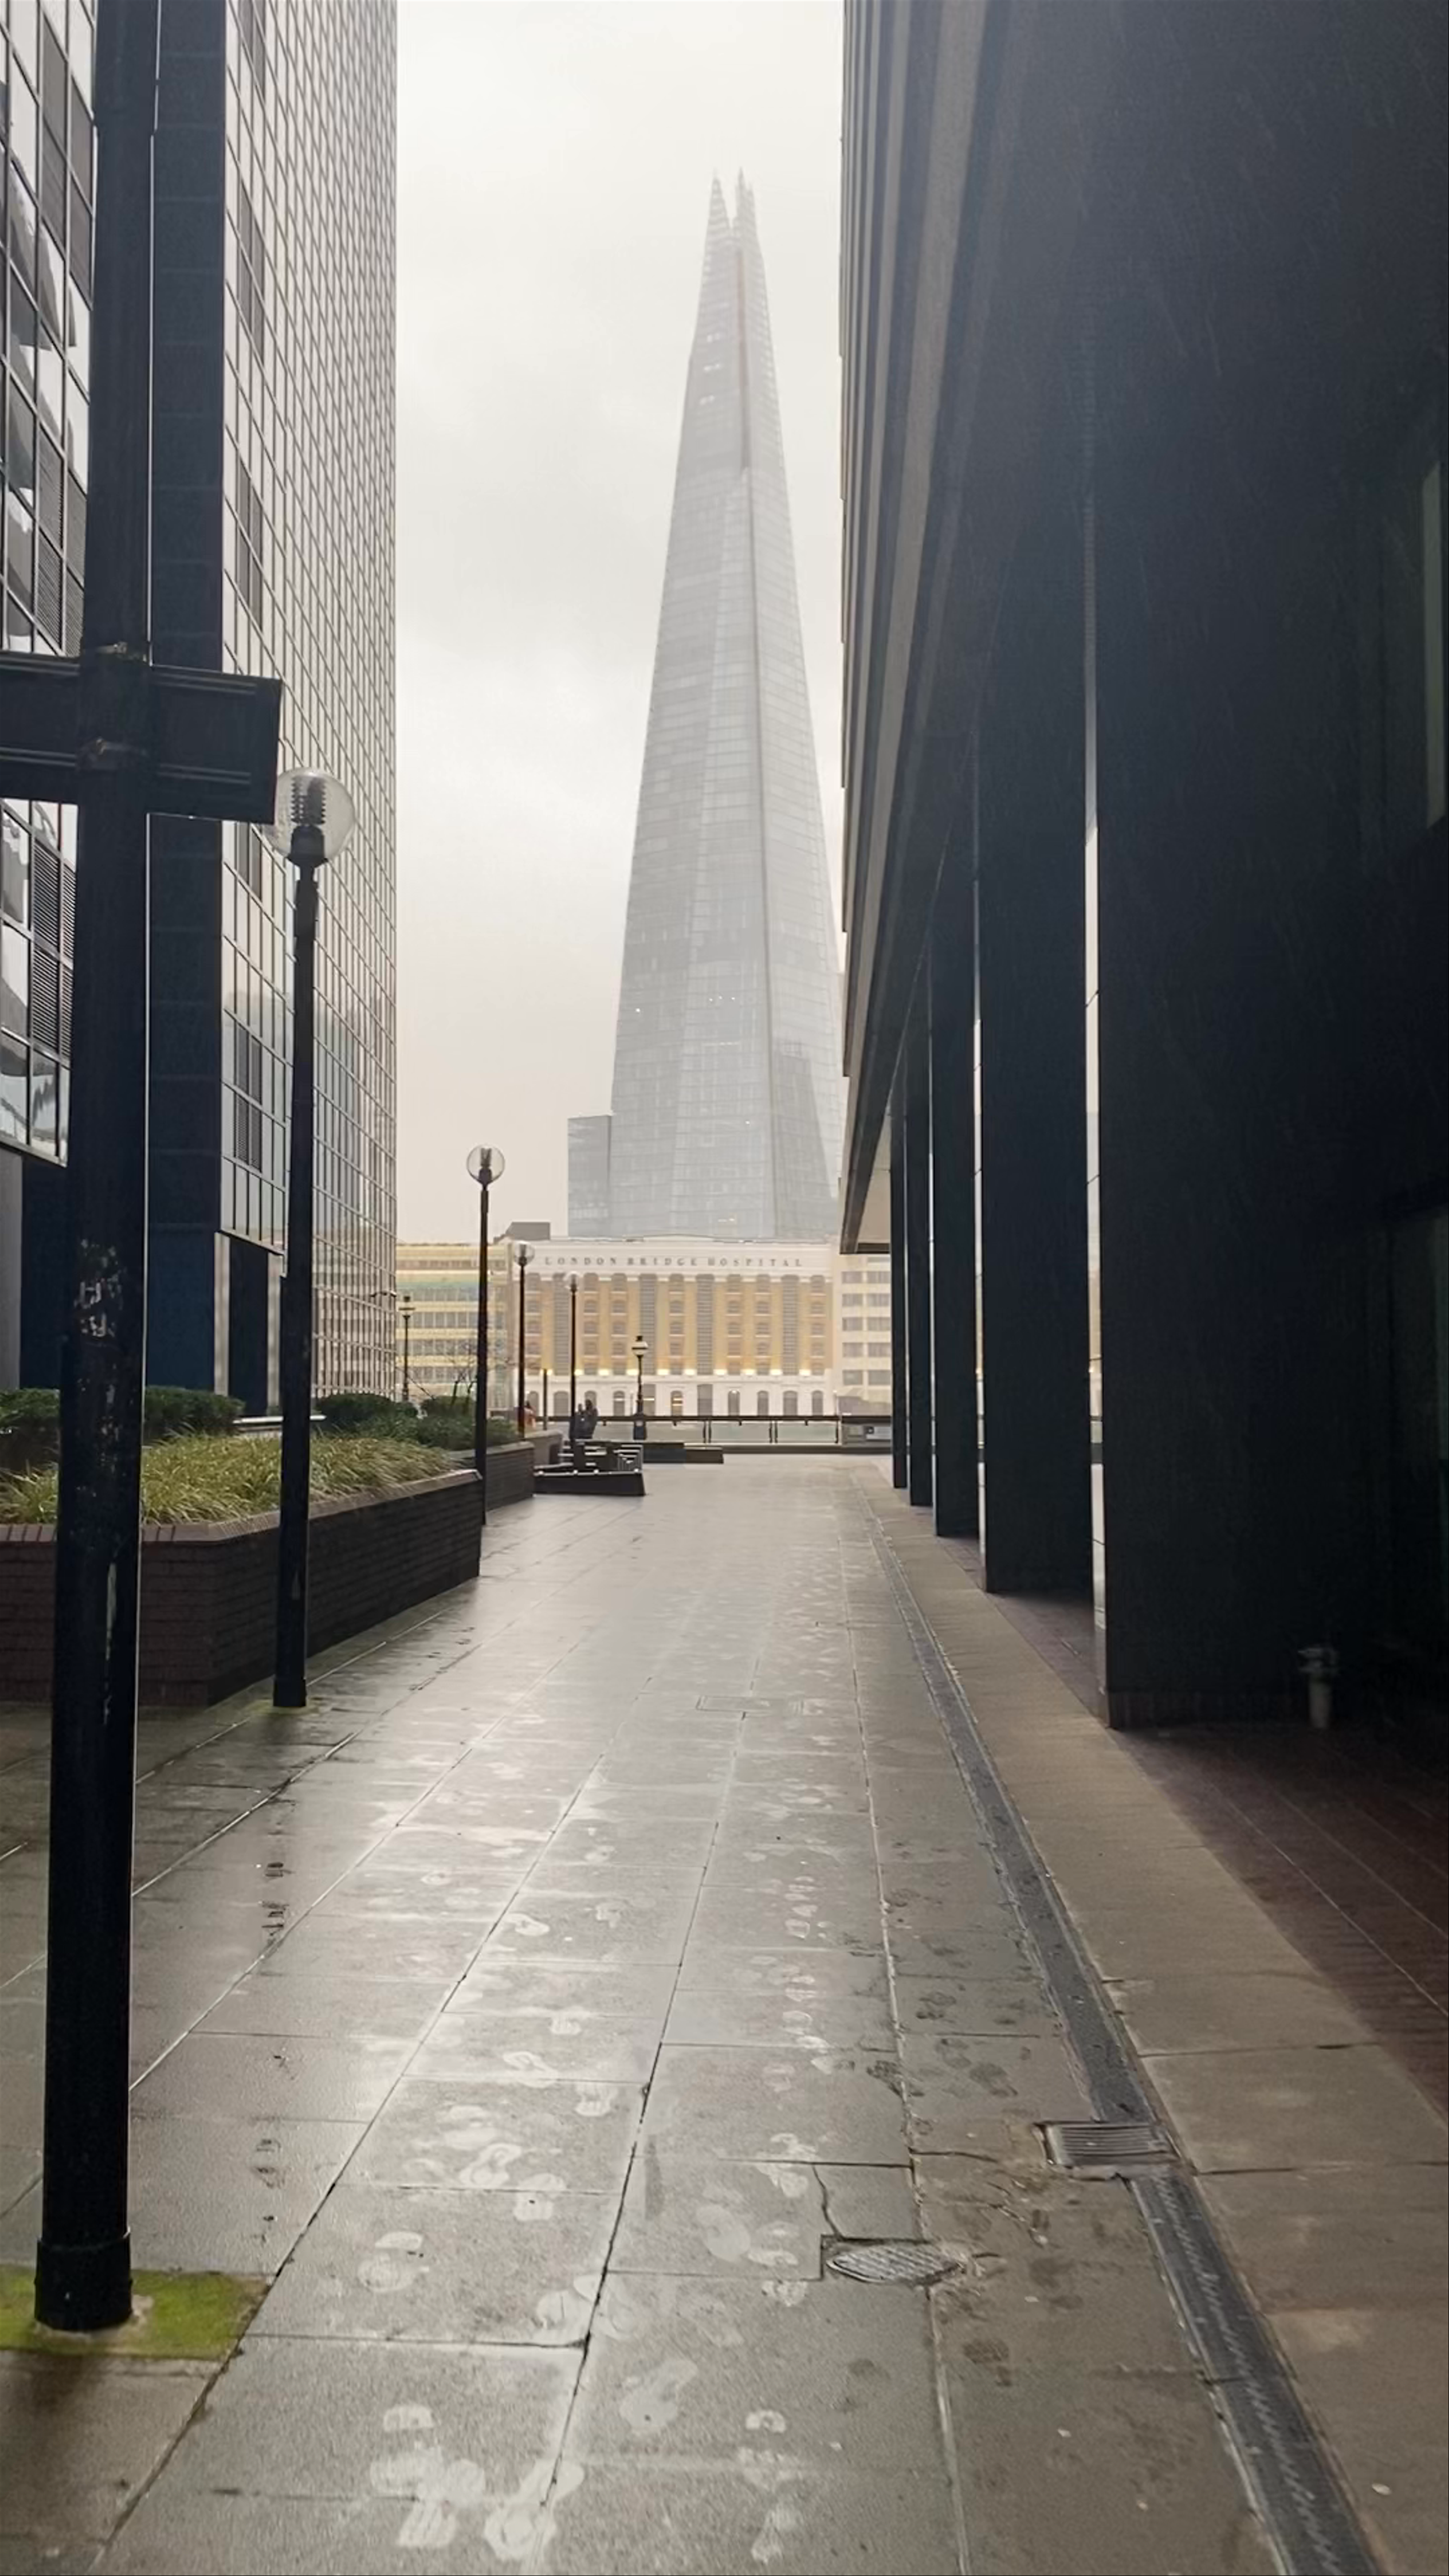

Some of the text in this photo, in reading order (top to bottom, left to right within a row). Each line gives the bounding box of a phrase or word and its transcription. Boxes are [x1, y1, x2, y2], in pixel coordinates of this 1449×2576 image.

[545, 1257, 802, 1266] LONDON BRIDGE HOSPITAL
